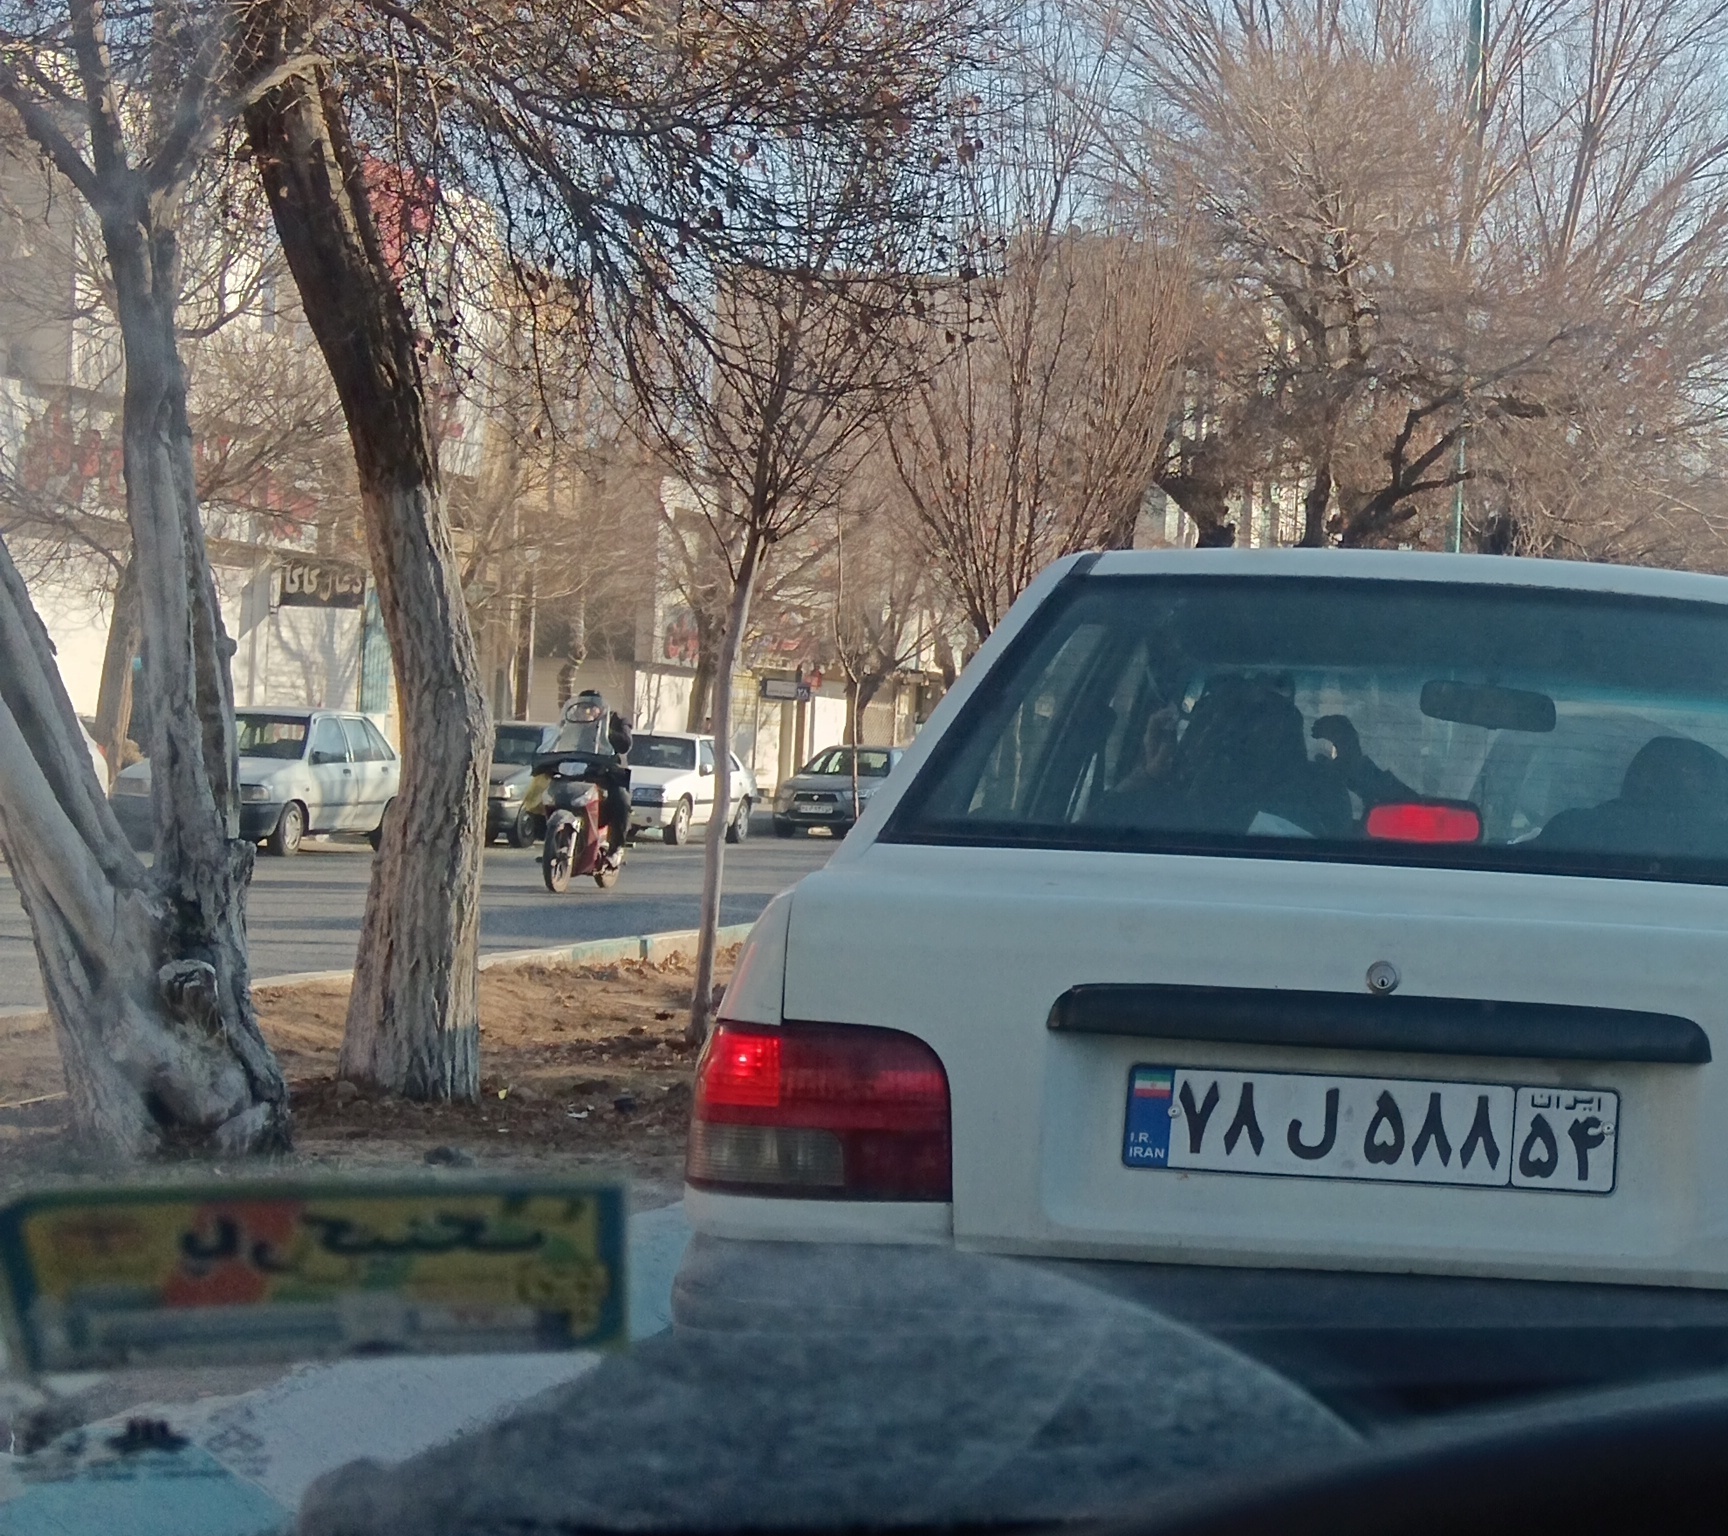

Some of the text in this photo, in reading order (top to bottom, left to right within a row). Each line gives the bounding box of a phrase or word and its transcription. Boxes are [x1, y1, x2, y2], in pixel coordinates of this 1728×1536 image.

[1530, 1092, 1602, 1112] ایران
[1129, 1132, 1152, 1144] I.R.
[1129, 1146, 1165, 1159] IRAN
[1519, 1113, 1606, 1181] ۵۴
